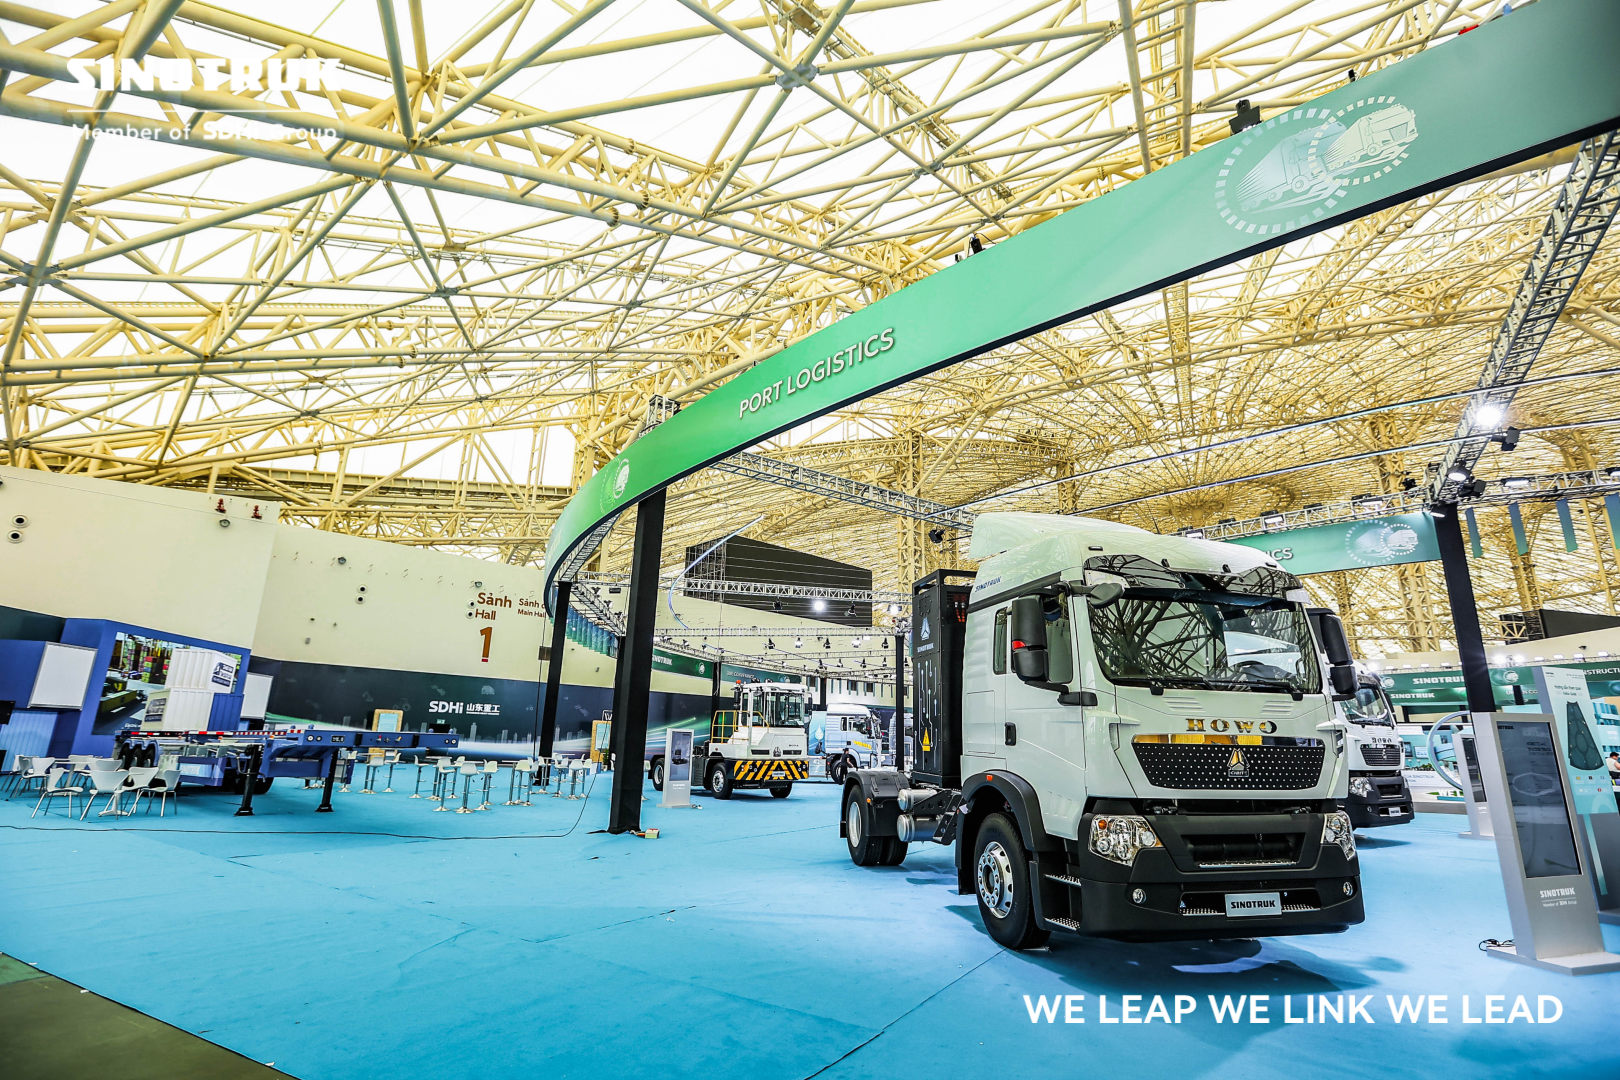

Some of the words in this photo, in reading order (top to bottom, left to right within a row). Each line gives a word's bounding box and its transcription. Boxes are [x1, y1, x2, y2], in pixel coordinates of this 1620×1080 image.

[739, 380, 783, 419] PORT
[787, 328, 894, 394] LOGISTICS
[477, 592, 512, 608] Sảnh
[519, 598, 540, 608] Sảnh
[475, 609, 496, 620] Hall
[480, 626, 492, 658] 1
[428, 700, 464, 714] SDHi
[466, 702, 501, 713] 山东重工
[1185, 718, 1277, 734] HOWO
[1539, 887, 1576, 898] SINOTRUK
[1230, 899, 1276, 910] SINOTRUK
